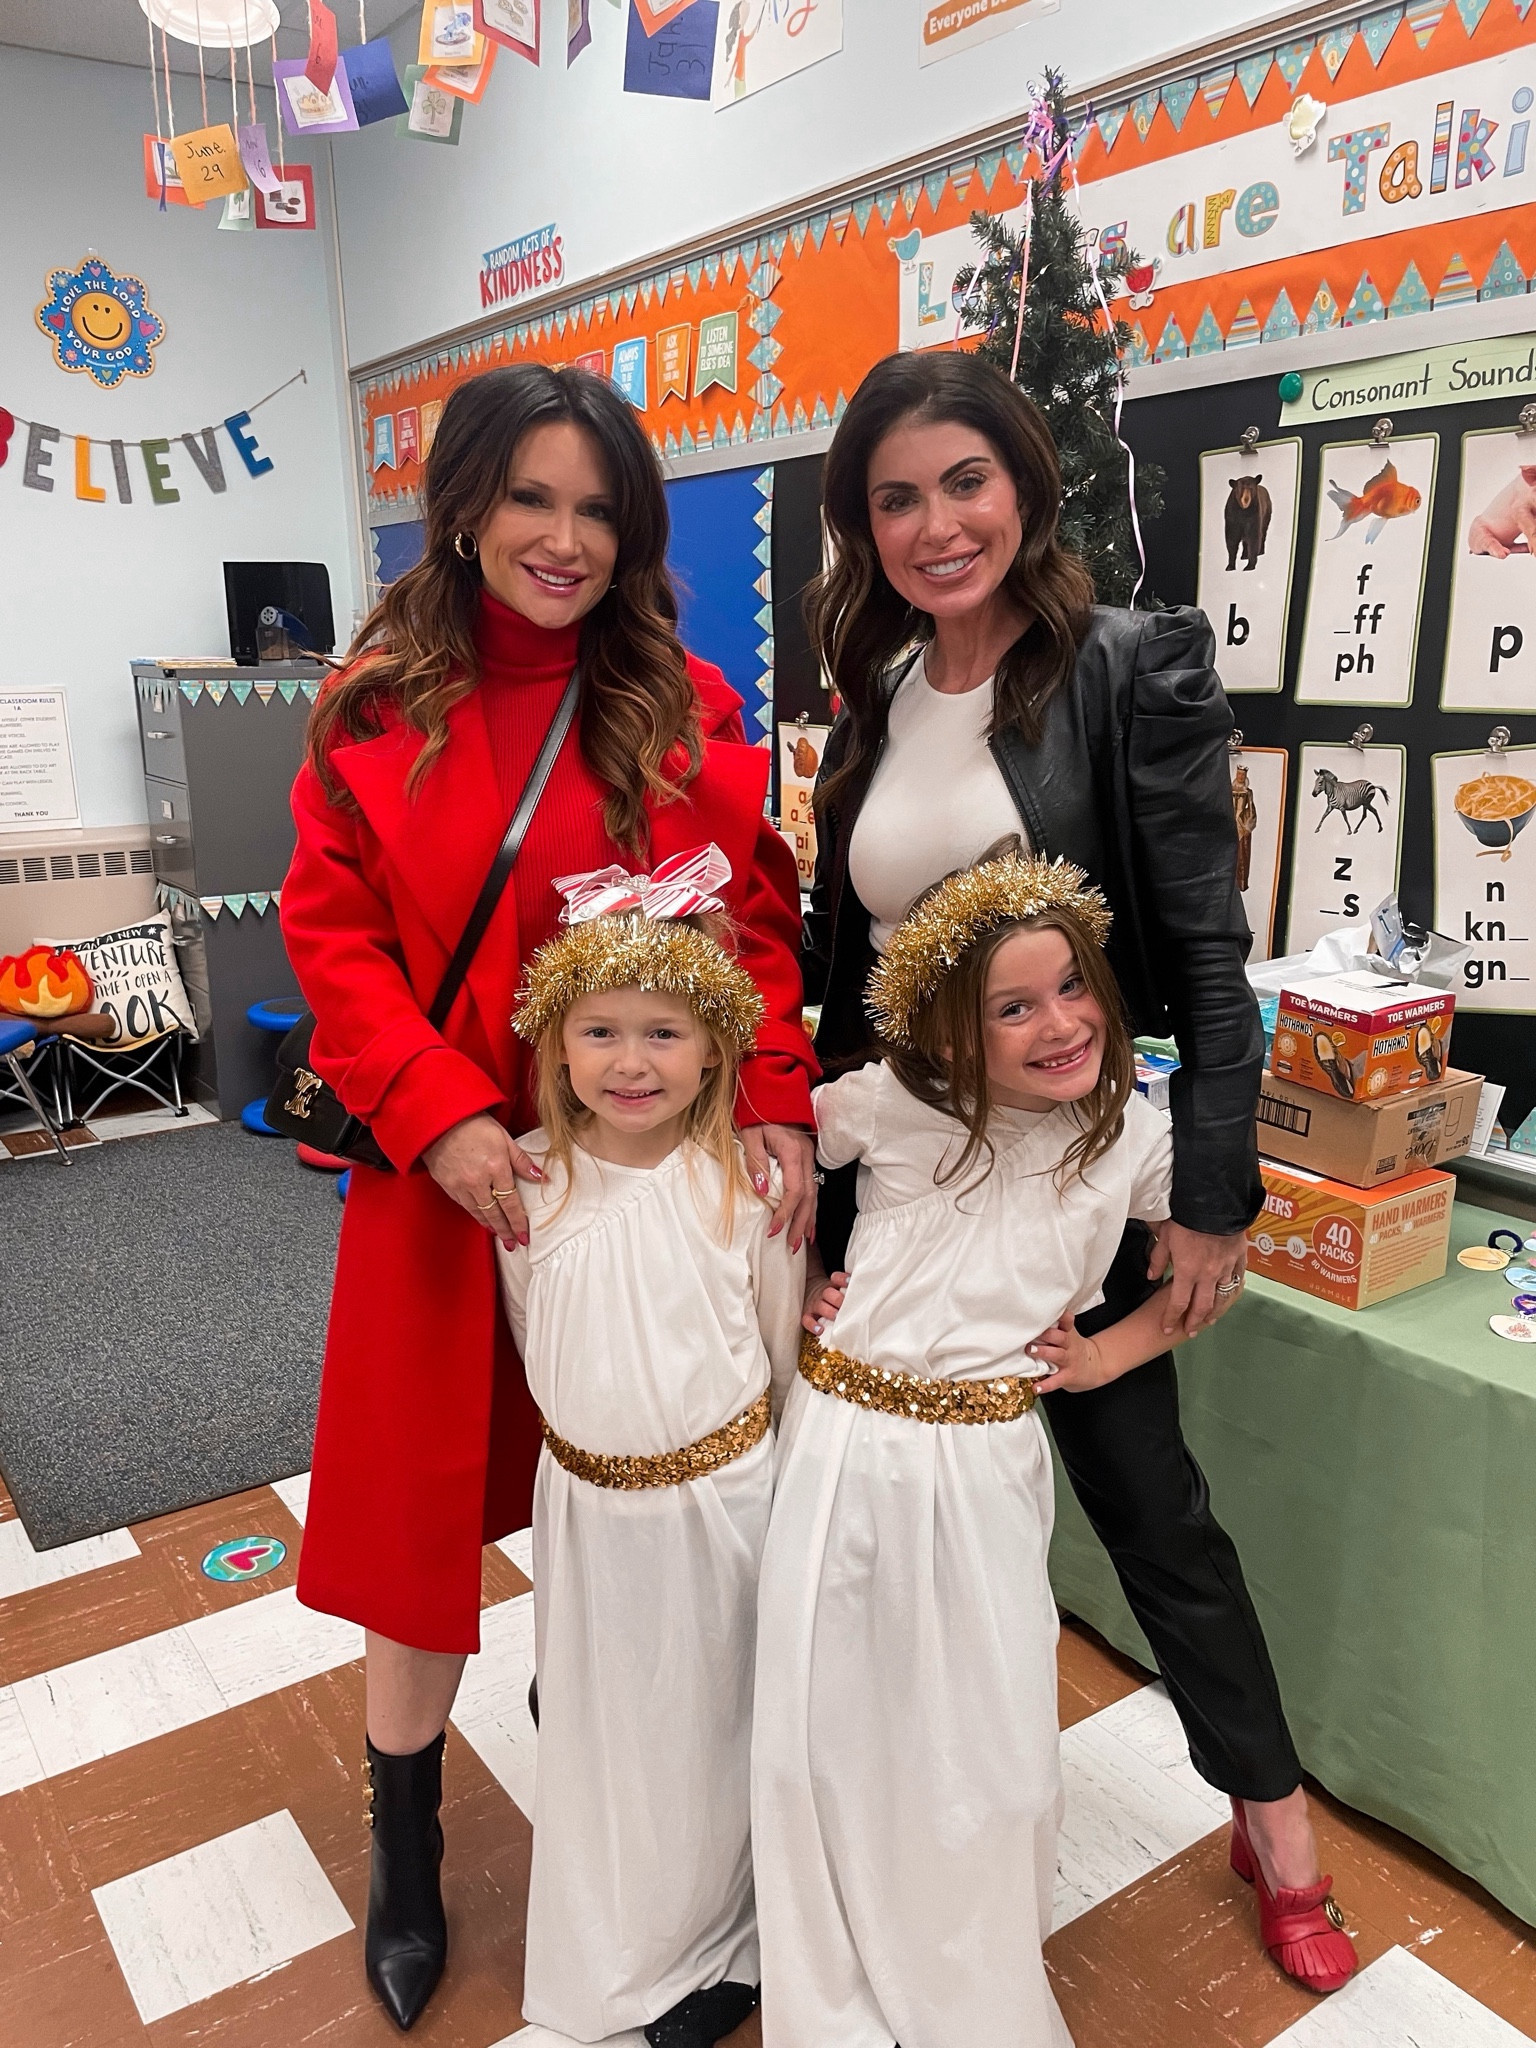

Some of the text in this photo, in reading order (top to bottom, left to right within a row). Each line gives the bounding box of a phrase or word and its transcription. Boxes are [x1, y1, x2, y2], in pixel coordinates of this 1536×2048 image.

[929, 1, 989, 35] Everyone
[200, 163, 225, 183] 29
[1166, 181, 1280, 258] are
[489, 229, 551, 270] RANDOM ACTS OF
[479, 236, 562, 308] KINDNESS
[61, 280, 141, 319] LOVE THE LORD
[66, 330, 100, 360] YOUR
[666, 333, 678, 349] ASK
[706, 325, 728, 345] LISTEN
[717, 355, 731, 369] IDEA
[1312, 363, 1433, 411] Consonant
[1357, 564, 1373, 595] f
[1226, 603, 1251, 646] b
[1335, 643, 1375, 682] ph
[1489, 625, 1524, 673] p
[798, 790, 807, 804] a
[796, 832, 809, 850] ai
[797, 858, 815, 878] ay
[1334, 857, 1353, 881] z
[1486, 881, 1505, 902] n
[106, 934, 114, 944] A
[117, 928, 143, 940] NEW
[78, 940, 168, 971] VENTURE
[94, 970, 173, 999] TIME I OPEN A
[98, 989, 190, 1044] OOK
[1290, 995, 1358, 1023] TOE WARMERS
[1387, 1000, 1445, 1024] TOE WARMERS
[1372, 1190, 1448, 1231] HAND WARMERS
[1326, 1222, 1352, 1249] 40
[1369, 1233, 1379, 1244] 40
[1413, 1210, 1446, 1229] WARMERS
[1319, 1242, 1355, 1265] PACKS
[1320, 1268, 1358, 1284] WARMERS
